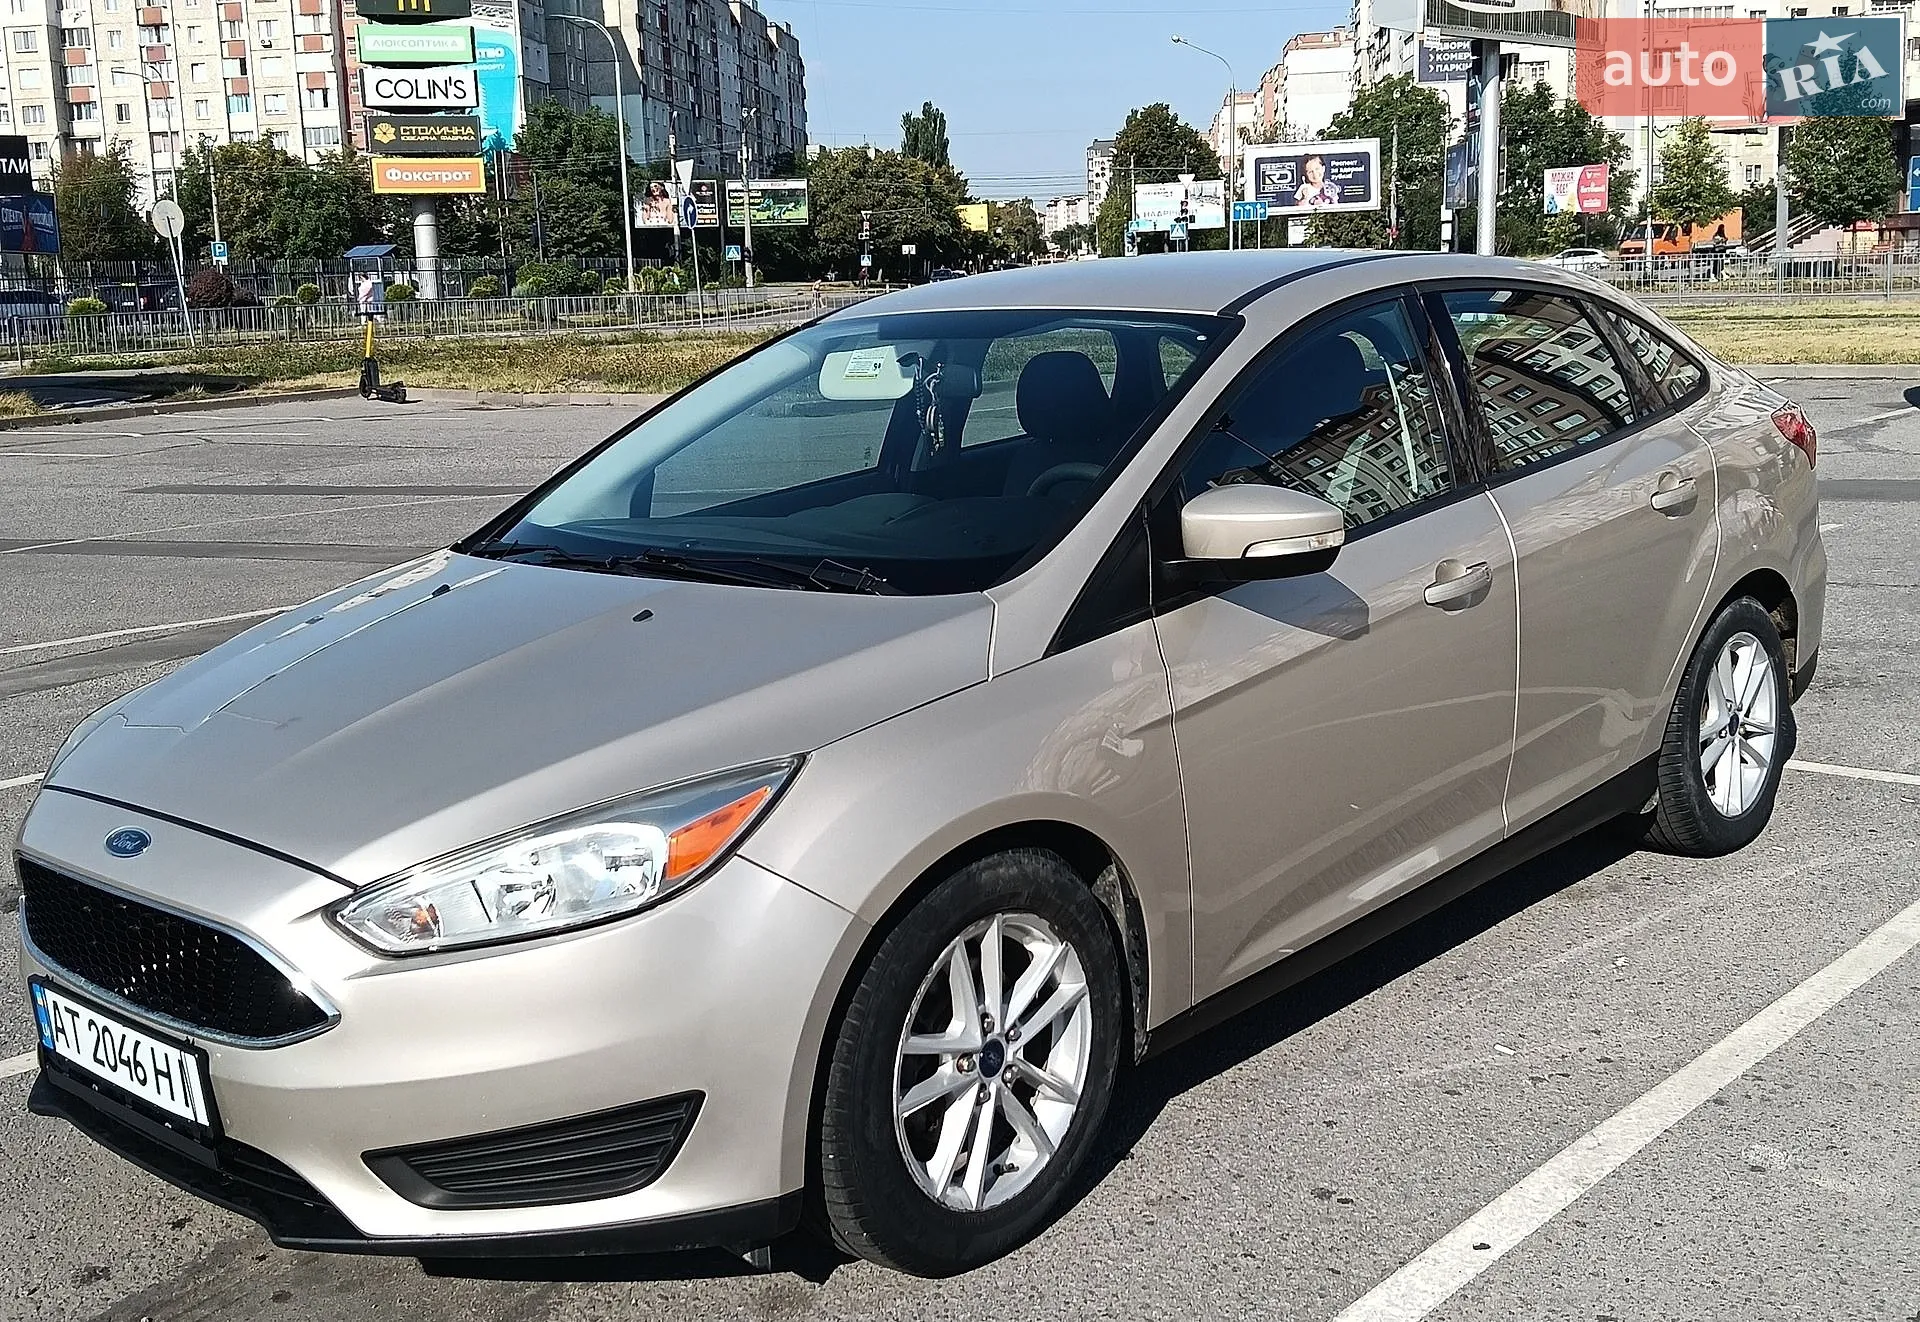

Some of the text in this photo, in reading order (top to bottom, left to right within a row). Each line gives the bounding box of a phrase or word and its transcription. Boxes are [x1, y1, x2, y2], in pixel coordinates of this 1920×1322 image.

[372, 39, 459, 48] ЛЮКСОПТИКА
[375, 76, 467, 100] COLIN'S
[400, 125, 476, 136] СТОЛИЧНА
[385, 167, 472, 184] Фокстрот
[215, 243, 225, 256] P
[112, 832, 141, 850] Ford
[52, 1000, 80, 1054] AT
[88, 1018, 148, 1087] 2046
